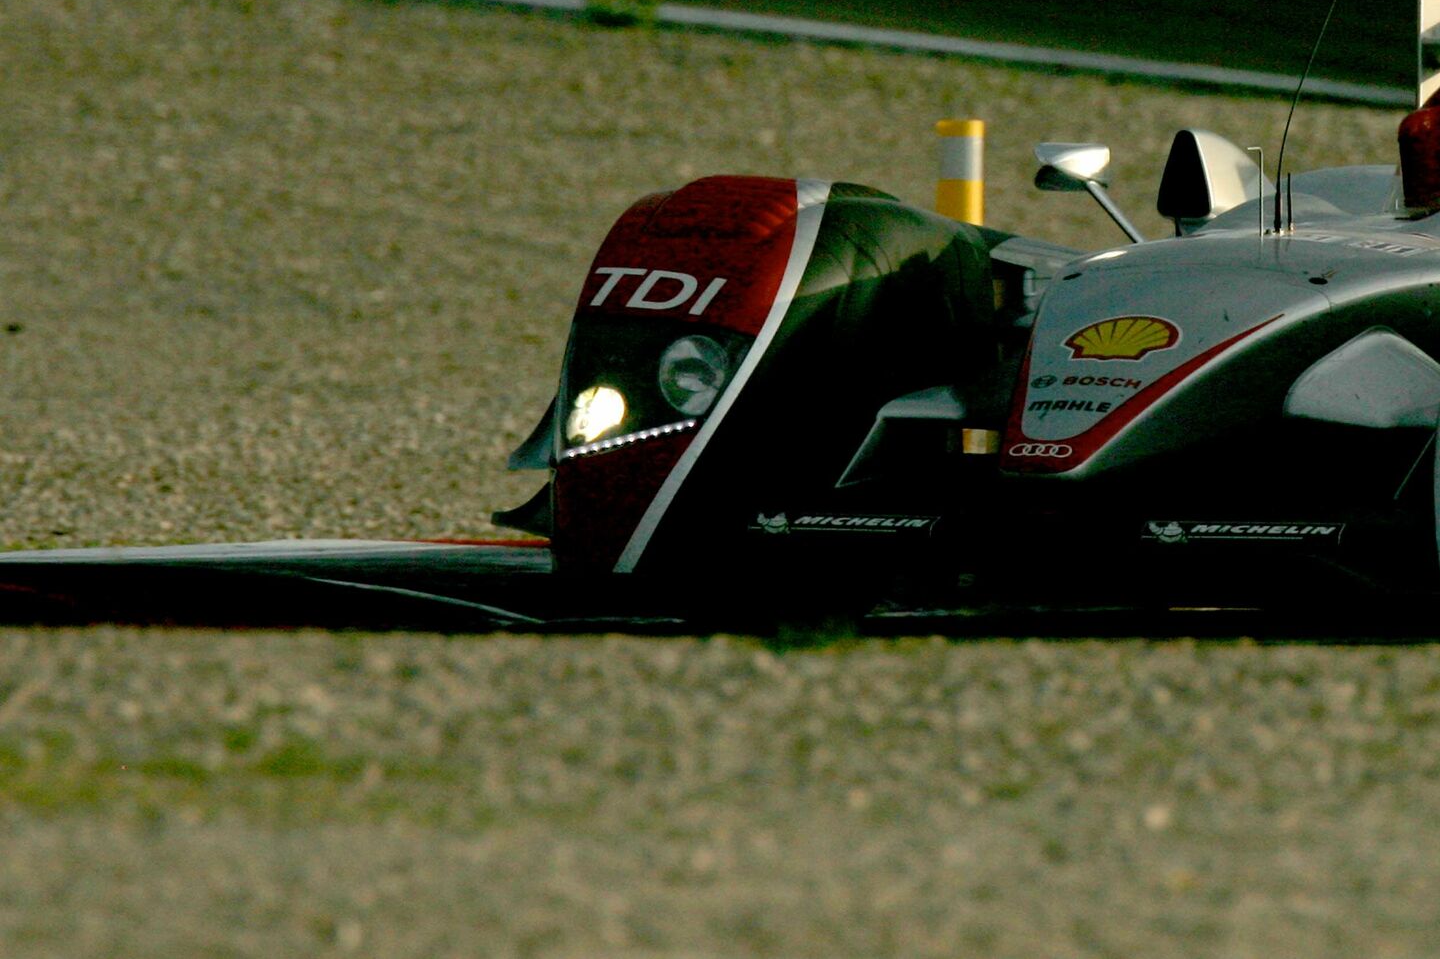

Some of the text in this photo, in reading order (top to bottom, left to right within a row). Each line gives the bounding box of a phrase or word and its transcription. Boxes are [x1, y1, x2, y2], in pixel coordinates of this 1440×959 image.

[589, 266, 728, 316] TDI
[1062, 376, 1141, 389] BOSCH
[793, 515, 931, 528] MICHELIN
[1190, 524, 1336, 535] MICHELIN
